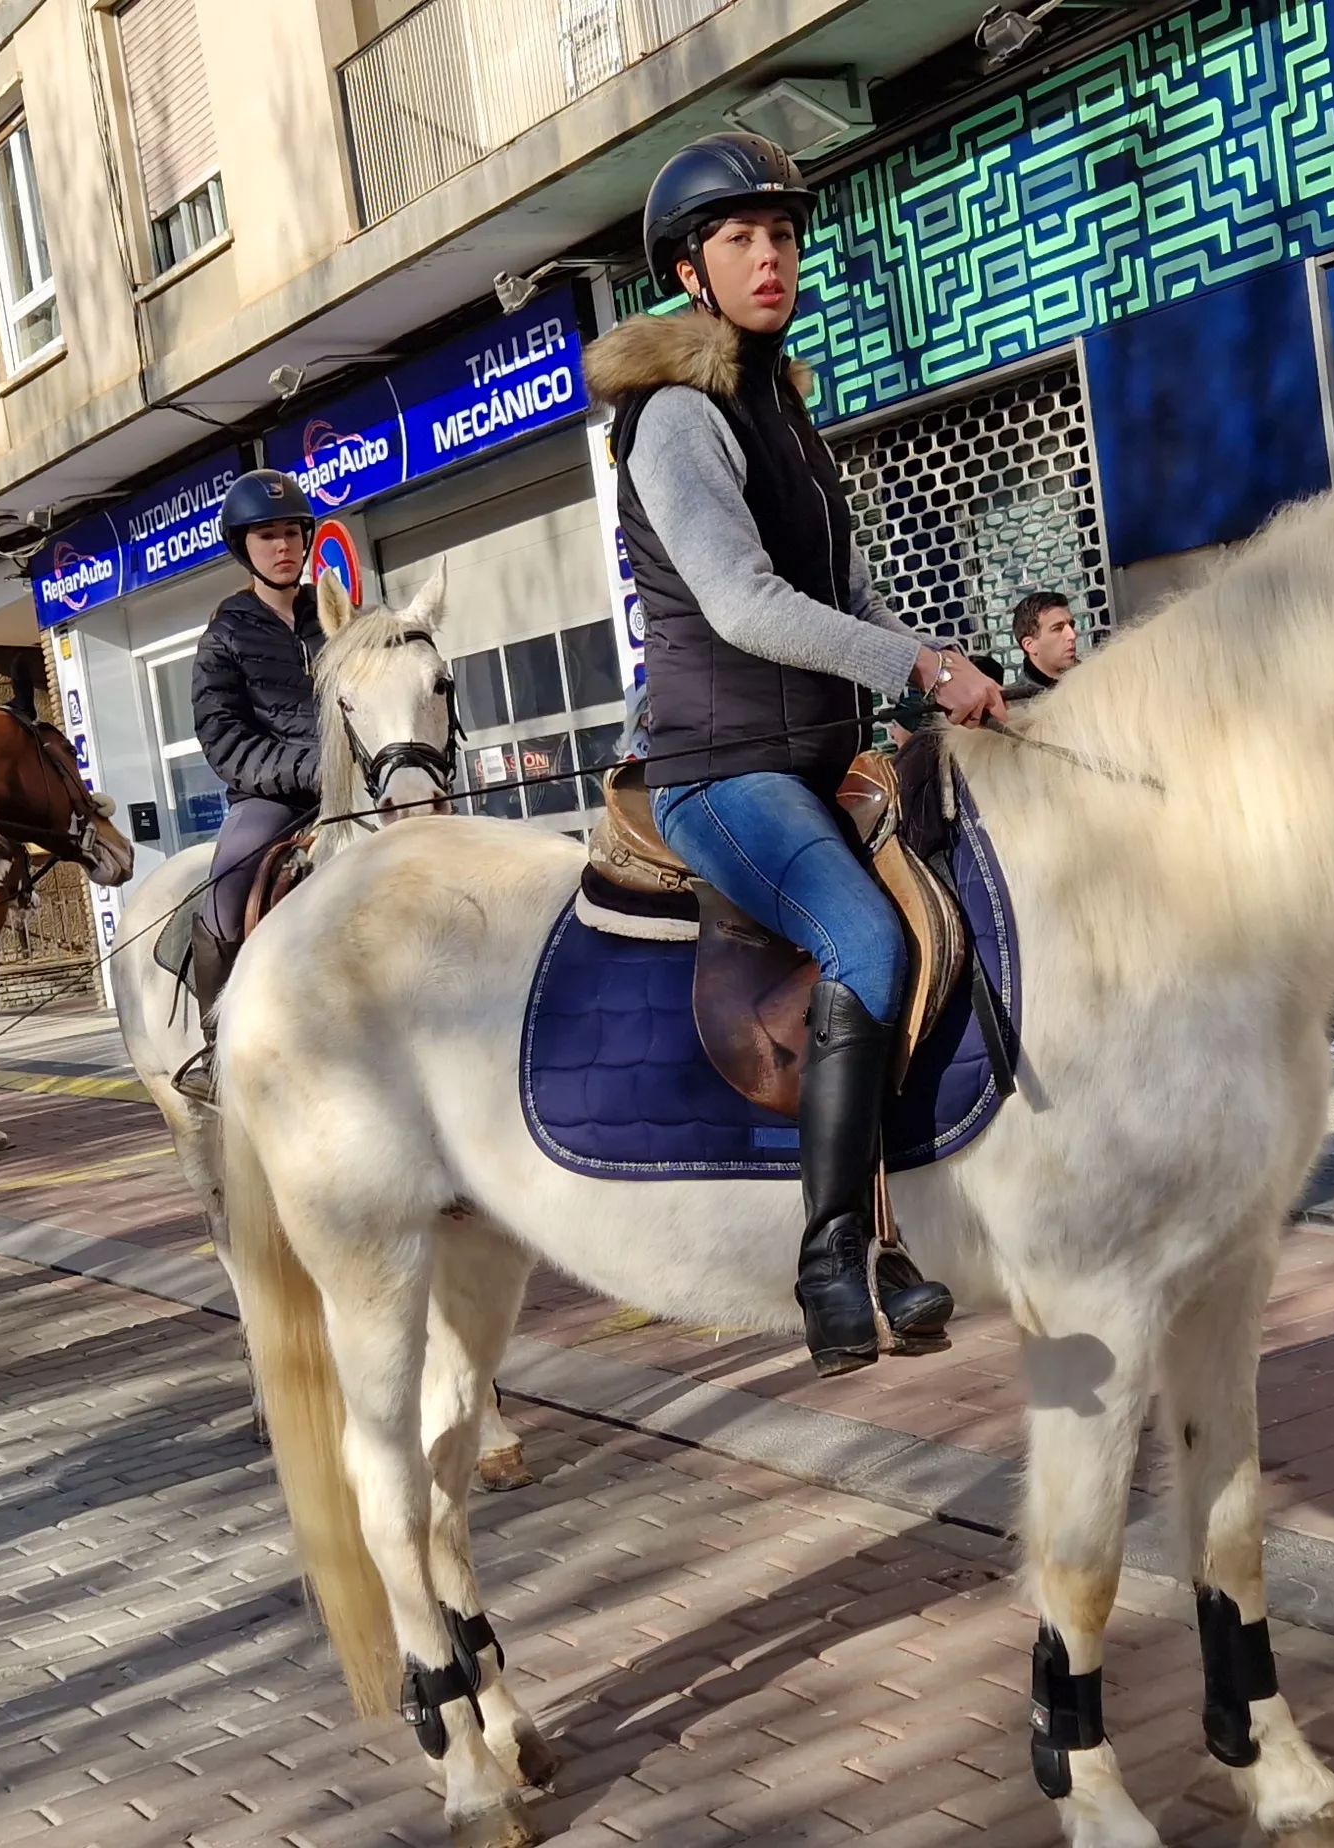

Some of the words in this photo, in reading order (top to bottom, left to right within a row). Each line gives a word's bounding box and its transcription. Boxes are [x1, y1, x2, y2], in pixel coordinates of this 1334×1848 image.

[464, 317, 566, 389] TALLER
[432, 366, 573, 454] MECÁNICO
[128, 470, 235, 544] AUTOMÓVILES
[145, 544, 168, 574] DE
[168, 510, 224, 565] OCASIÓ
[41, 558, 113, 604] ReparAuto
